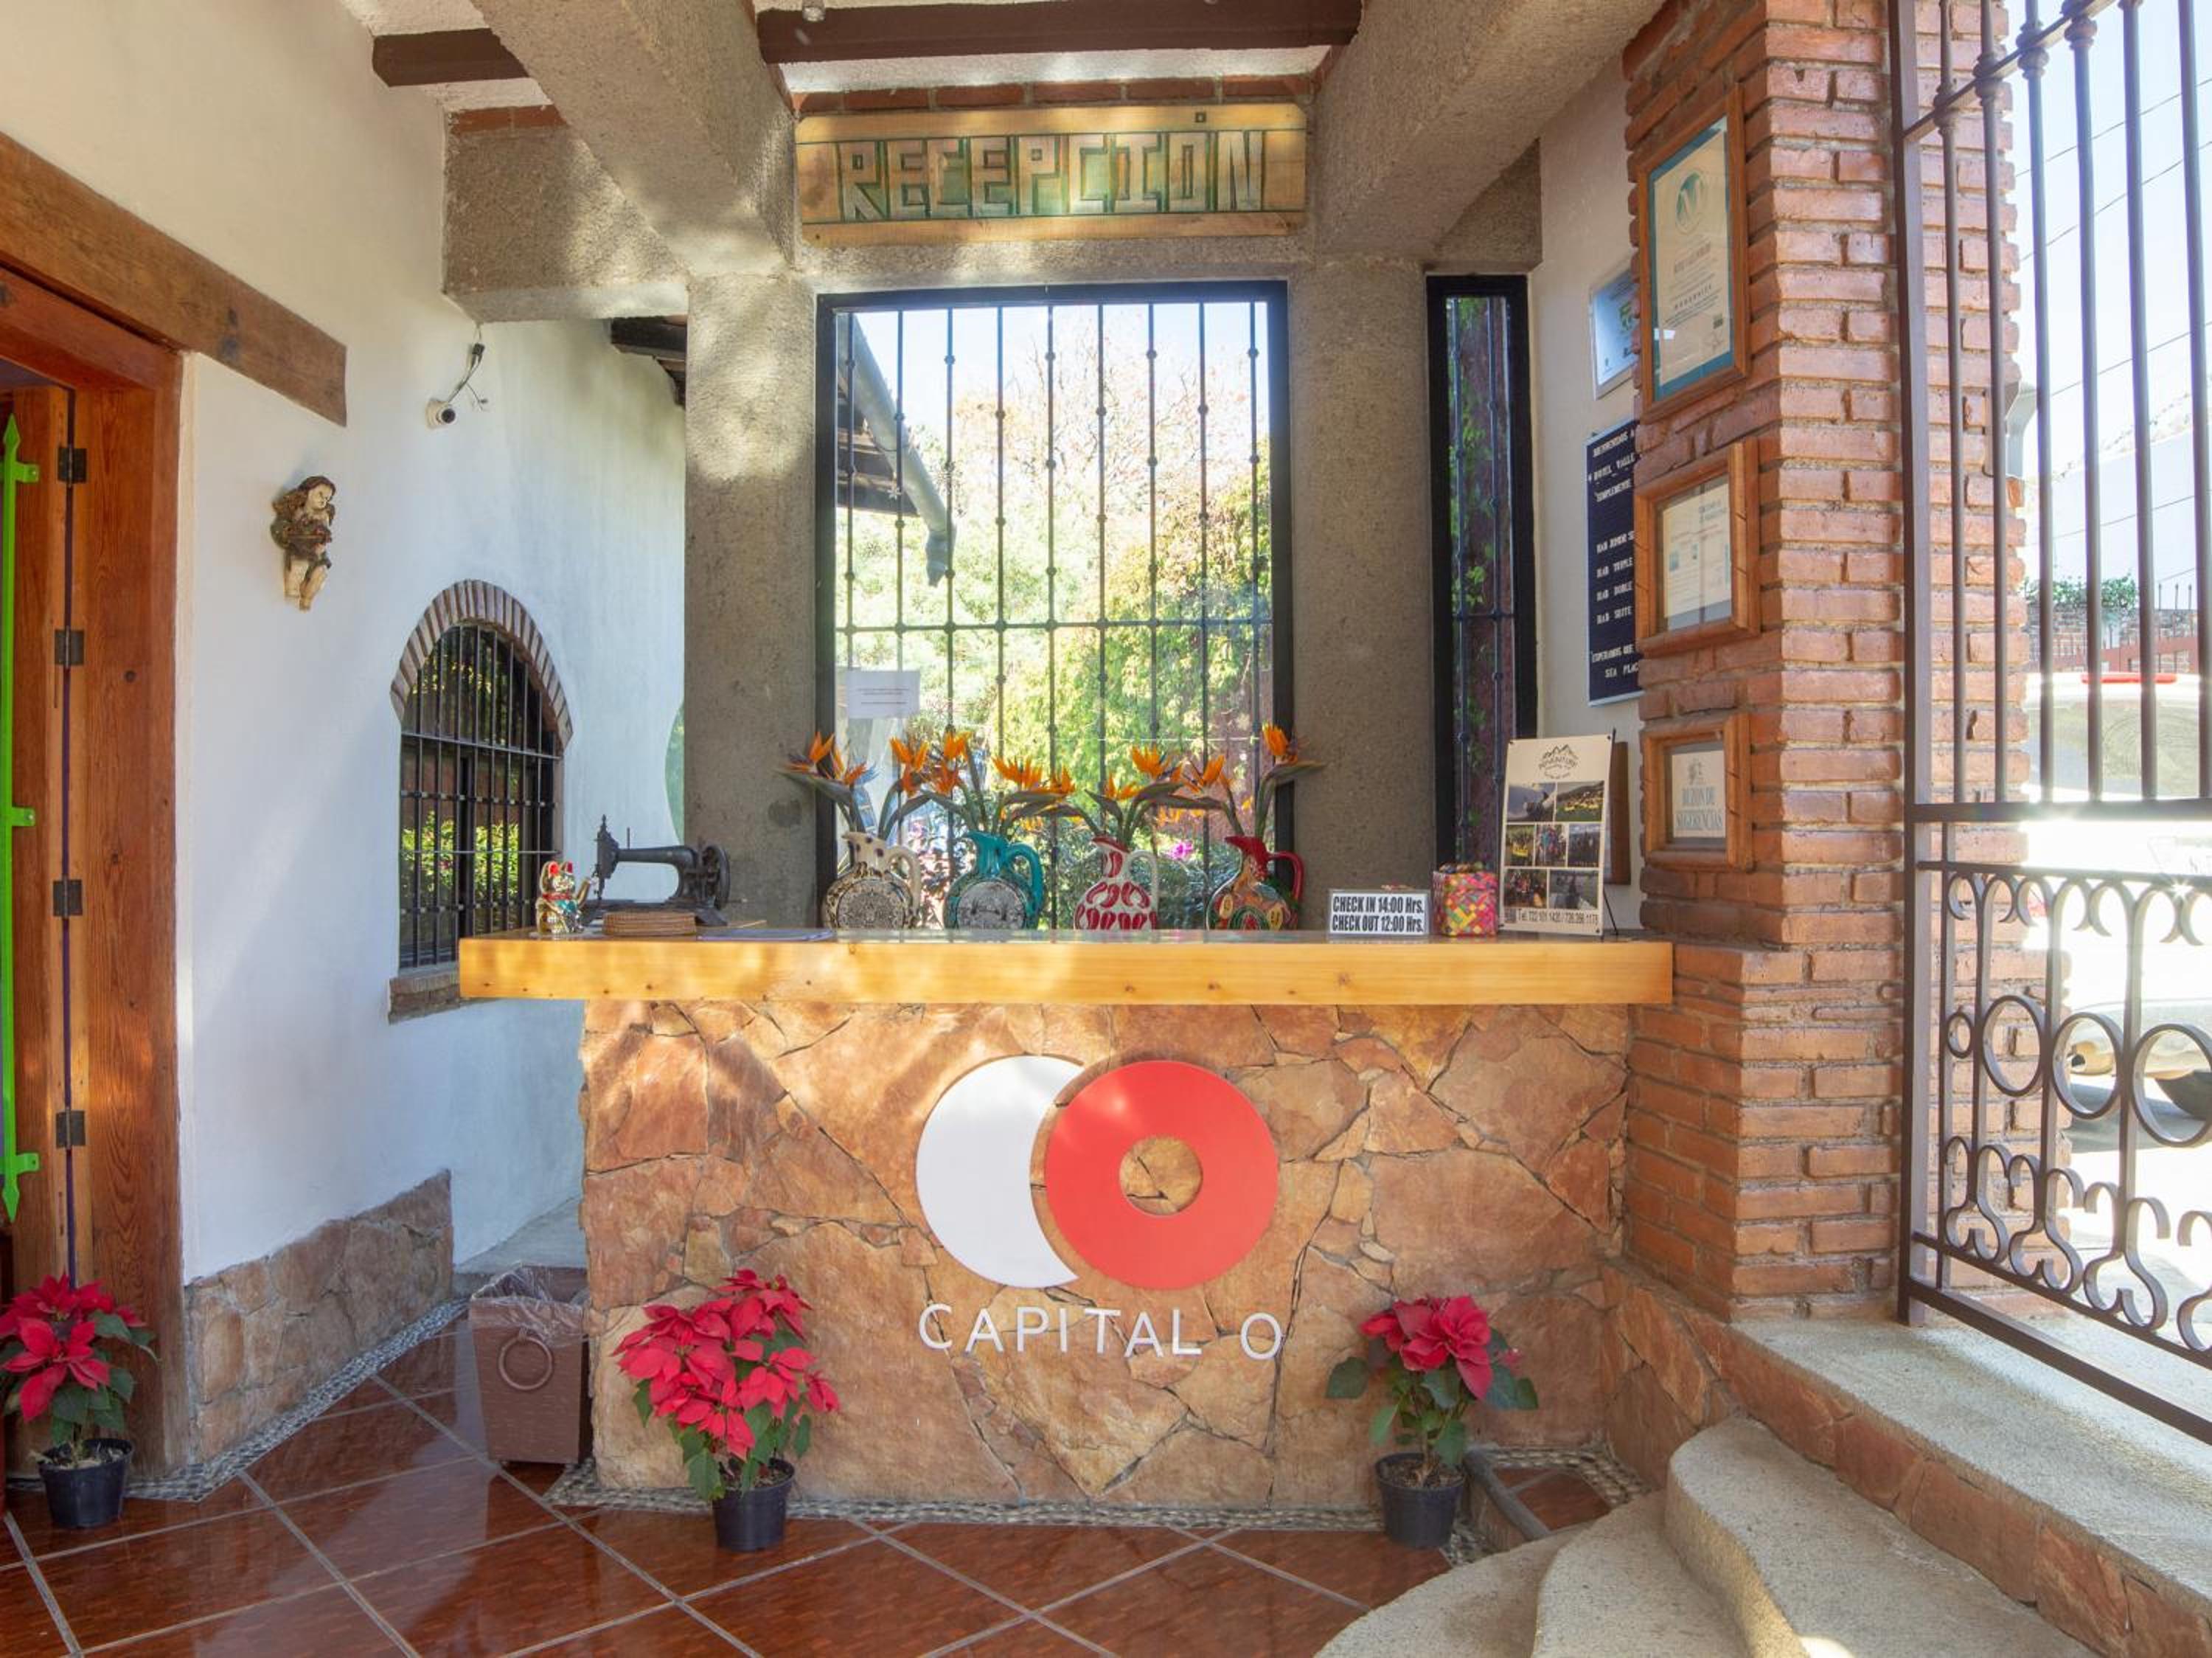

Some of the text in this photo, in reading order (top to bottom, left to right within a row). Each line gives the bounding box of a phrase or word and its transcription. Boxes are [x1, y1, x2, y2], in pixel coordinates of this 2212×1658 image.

[1332, 896, 1423, 913] CHECK IN 14:00 Hrs.
[1332, 915, 1423, 932] CHECK OUT 12:00 Hrs.
[918, 1303, 1286, 1361] CAPITAL O
